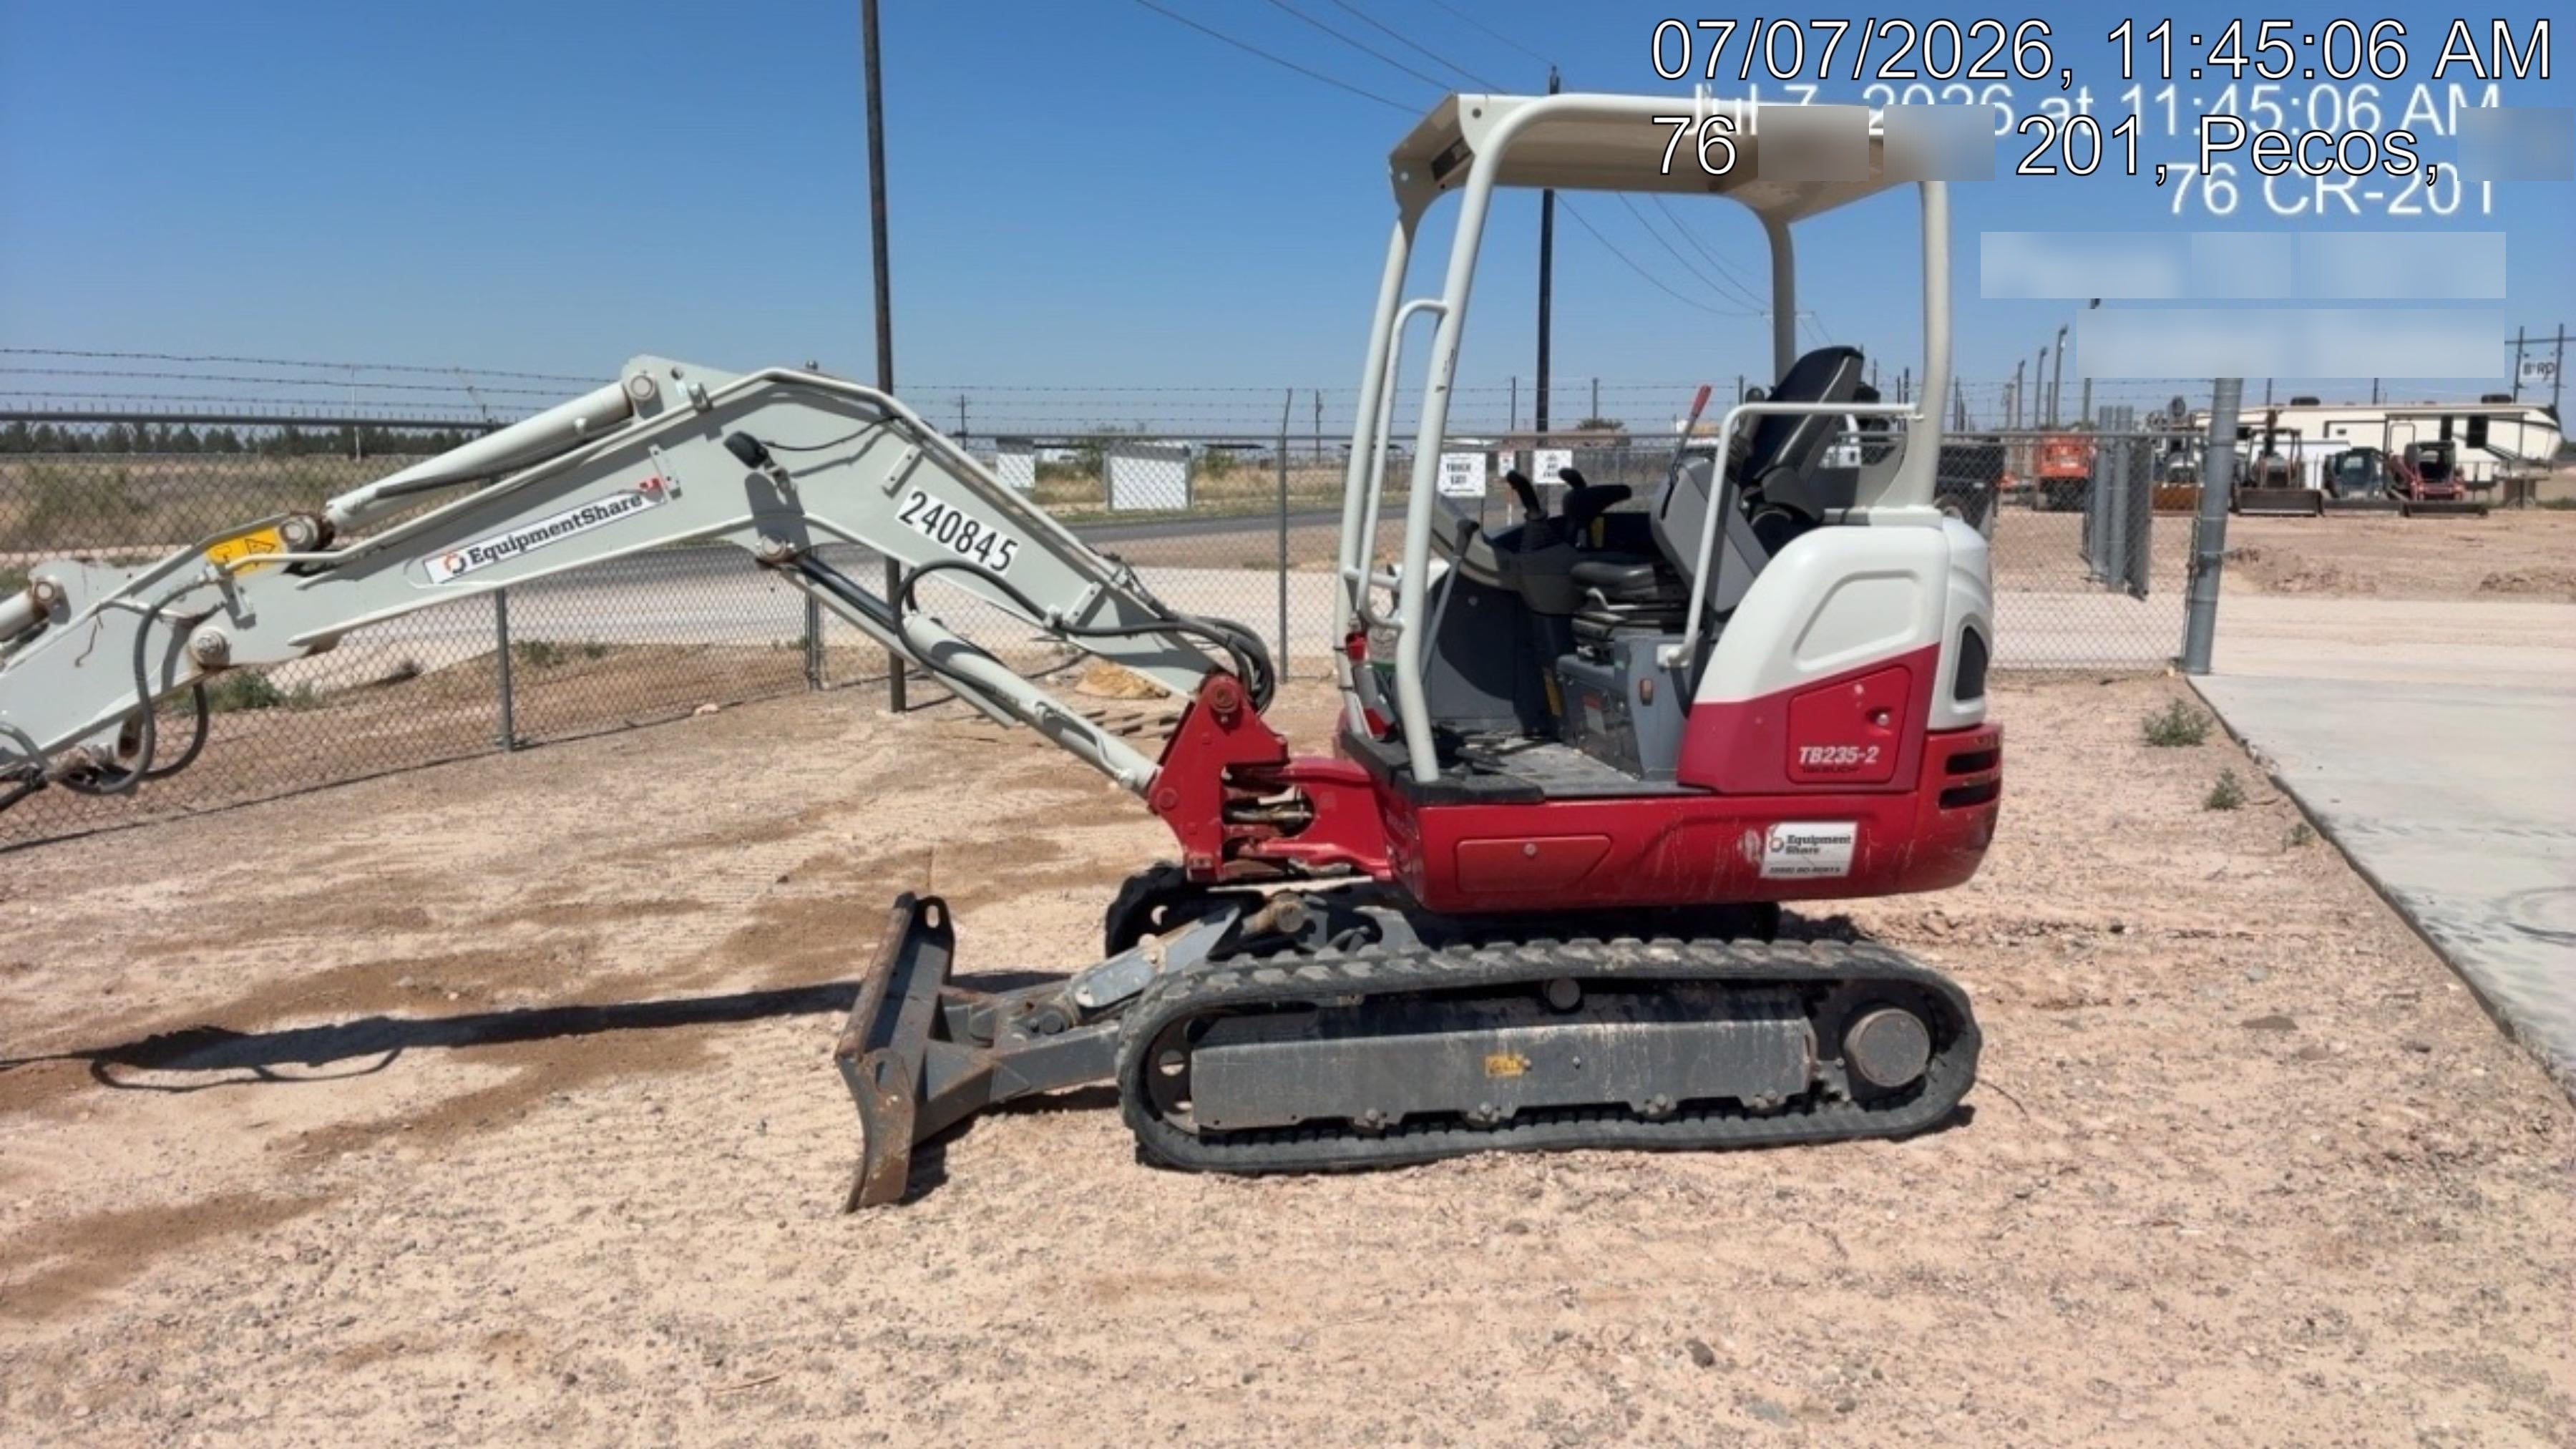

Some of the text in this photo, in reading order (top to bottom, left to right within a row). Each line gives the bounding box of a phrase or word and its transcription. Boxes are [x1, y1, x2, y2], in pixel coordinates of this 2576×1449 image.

[467, 494, 643, 565] EquipmentShare
[899, 490, 1018, 572] 240845
[1798, 746, 1880, 765] TB235-2
[1786, 834, 1852, 847] Equipment
[1785, 846, 1820, 855] Share
